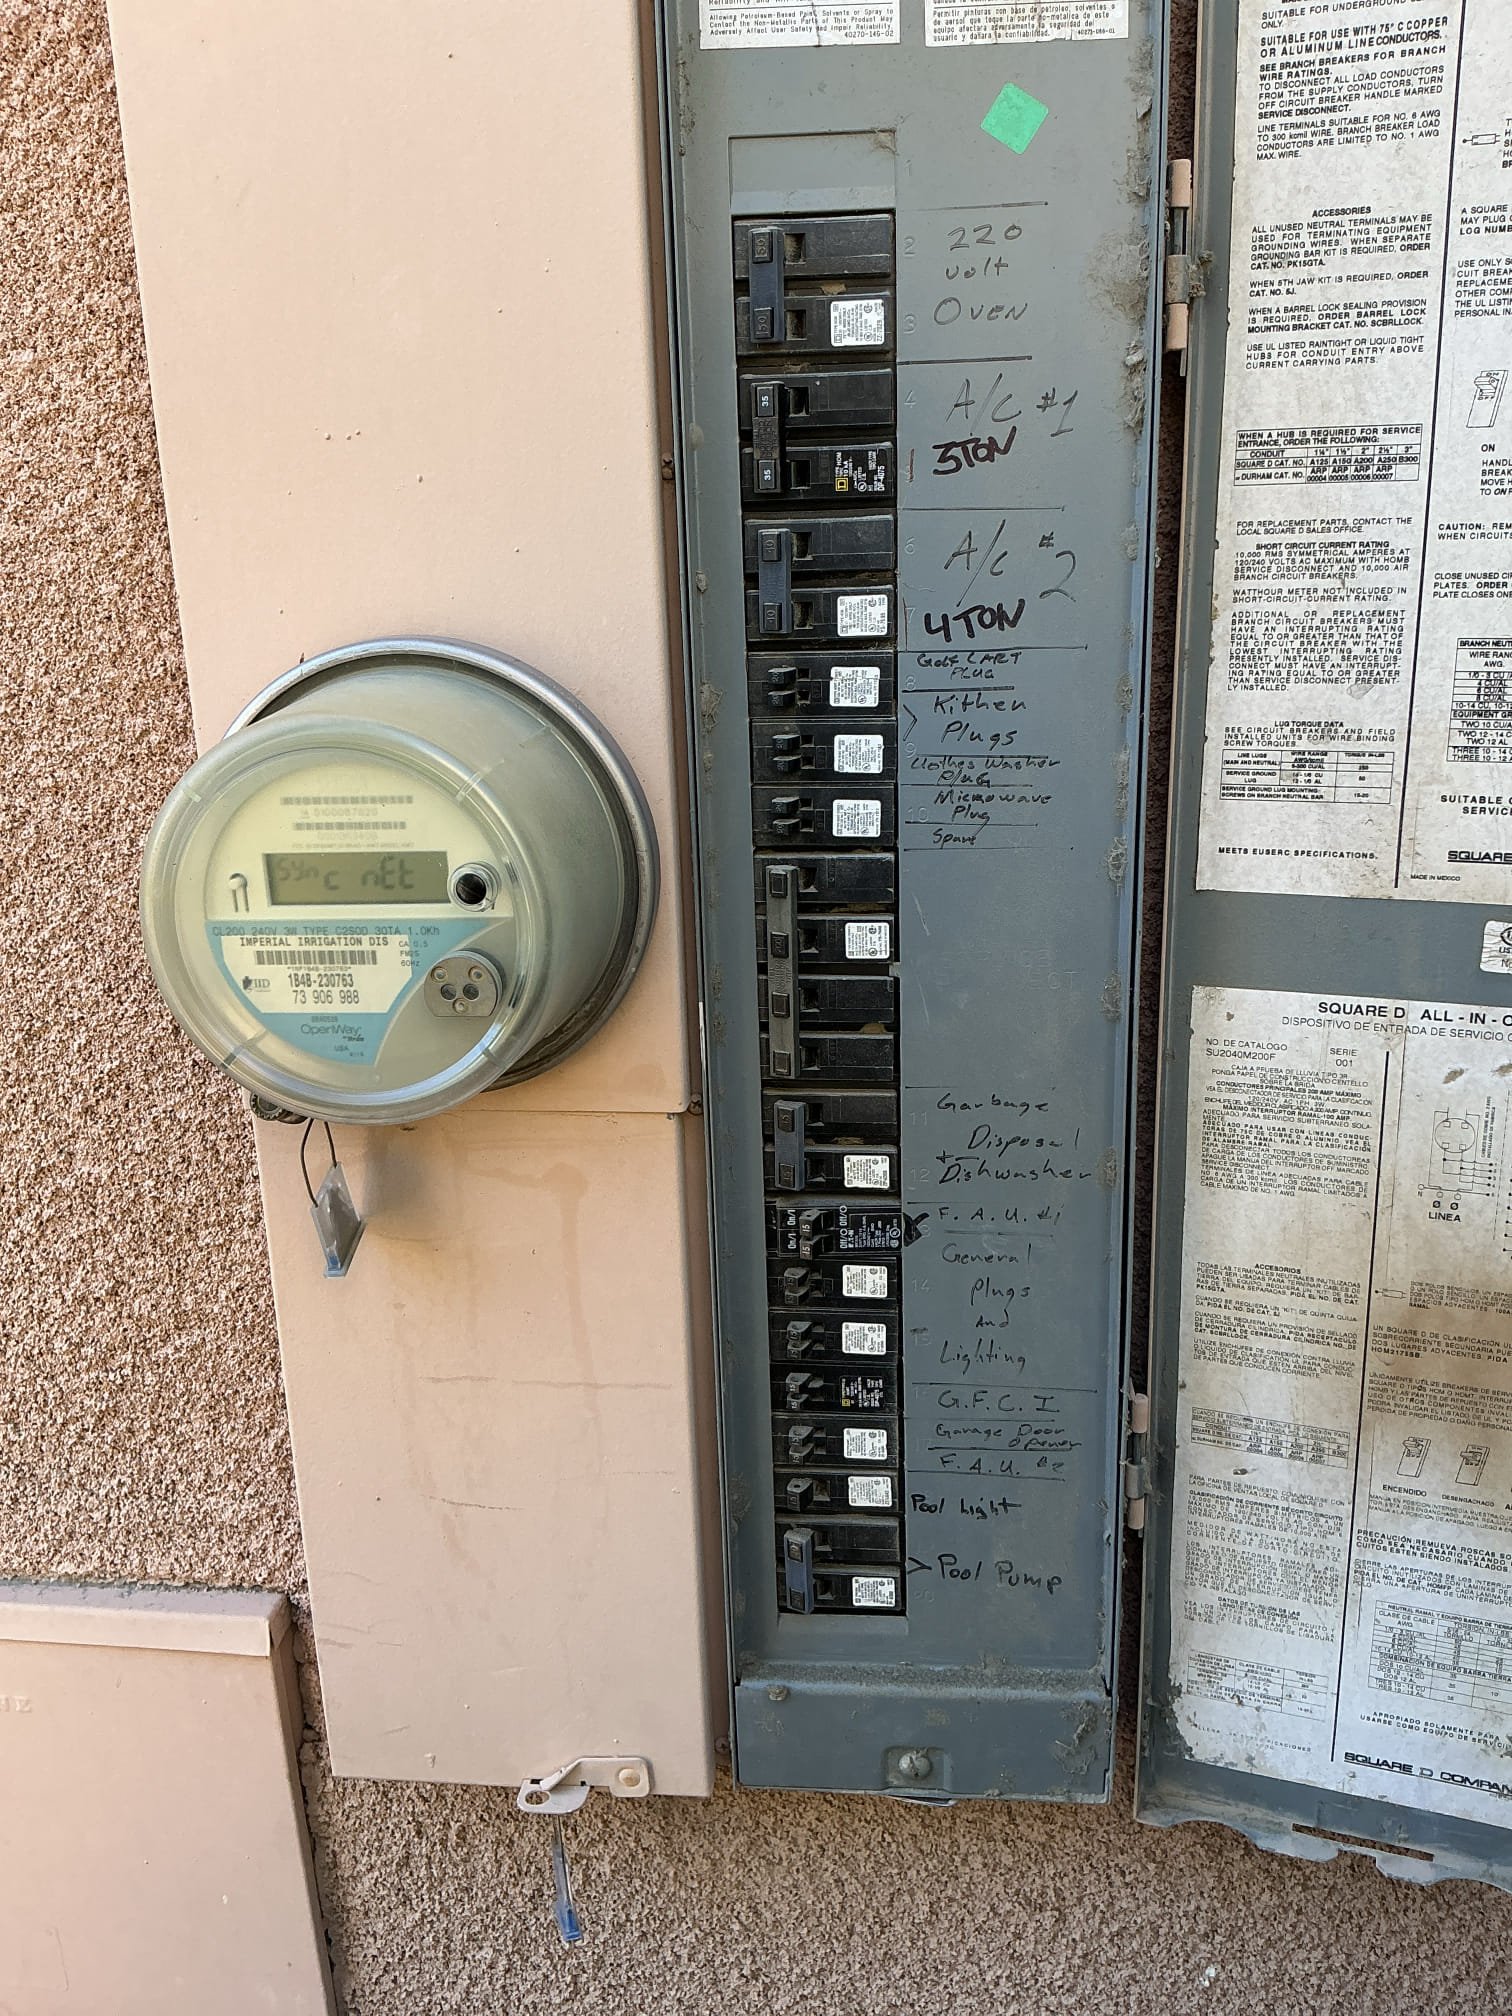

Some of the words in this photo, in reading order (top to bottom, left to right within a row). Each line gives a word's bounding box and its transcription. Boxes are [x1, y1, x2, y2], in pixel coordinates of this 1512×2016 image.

[1260, 33, 1306, 46] SUITABLE
[1307, 29, 1328, 41] FOR
[1330, 27, 1349, 39] USE
[1352, 24, 1377, 36] WITH
[1396, 21, 1404, 31] C
[1405, 16, 1448, 30] COPPER
[1260, 48, 1277, 58] OR
[1281, 40, 1343, 56] ALUMINUM
[1348, 38, 1374, 49] LINE
[1260, 62, 1277, 72] SEE
[1278, 58, 1316, 70] BRANCH
[1317, 52, 1370, 66] BREAKERS
[1372, 50, 1395, 60] FOR
[1399, 44, 1446, 57] BRANCH
[1260, 71, 1283, 82] WIRE
[1286, 68, 1332, 80] RATINGS.
[1312, 206, 1372, 217] ACCESSORIES
[948, 224, 1022, 251] 220
[762, 396, 769, 407] 35
[1238, 431, 1264, 440] WHEN
[1266, 430, 1272, 439] A
[1276, 430, 1295, 439] HUB
[1298, 429, 1309, 438] IS
[1309, 428, 1356, 438] REQUIRED
[1359, 427, 1378, 437] FOR
[1382, 426, 1420, 434] SERVICE
[764, 470, 771, 481] 35
[1438, 523, 1486, 532] CAUTION:
[1441, 795, 1502, 804] SUITABLE
[1218, 846, 1248, 855] MEETS
[1252, 847, 1289, 856] EUSERC
[1293, 849, 1377, 859] SPECIFICATIONS.
[240, 938, 291, 946] IMPERIAL
[299, 938, 362, 946] IRRIGATION
[369, 937, 388, 946] DIS
[292, 990, 306, 1004] 73
[313, 990, 333, 1004] 906
[339, 990, 360, 1004] 988
[1319, 1002, 1388, 1018] SQUARE
[1394, 1007, 1406, 1018] D
[1420, 1009, 1454, 1022] ALL
[1470, 1012, 1486, 1024] IN
[1282, 1016, 1350, 1030] DISPOSITIVO
[1354, 1022, 1370, 1032] DE
[1373, 1022, 1426, 1036] ENTRADA
[1430, 1027, 1446, 1036] DE
[1450, 1028, 1504, 1041] SERVICIO
[1224, 1039, 1236, 1047] DE
[1238, 1040, 1288, 1050] CATALOGO
[1206, 1048, 1276, 1061] SU2040M200F
[1330, 1048, 1358, 1057] SERIE
[1336, 1058, 1353, 1068] 001
[937, 1093, 1050, 1114] Garbage
[939, 1159, 1093, 1185] Dishwasher
[1429, 1211, 1462, 1222] LINEA
[942, 1244, 1032, 1264] General
[970, 1276, 1032, 1304] Plugs
[940, 1341, 1027, 1374] Lighting
[1383, 1484, 1426, 1496] ENCENDIDO
[912, 1494, 946, 1514] Pool
[960, 1495, 1022, 1519] Light
[938, 1554, 980, 1582] Pool
[995, 1560, 1062, 1593] Pump
[1374, 1712, 1420, 1724] APROPIADO
[1424, 1722, 1474, 1736] SOLAMENTE
[1478, 1732, 1500, 1740] PARA
[1345, 1752, 1413, 1774] SQUARE
[1420, 1768, 1434, 1778] D
